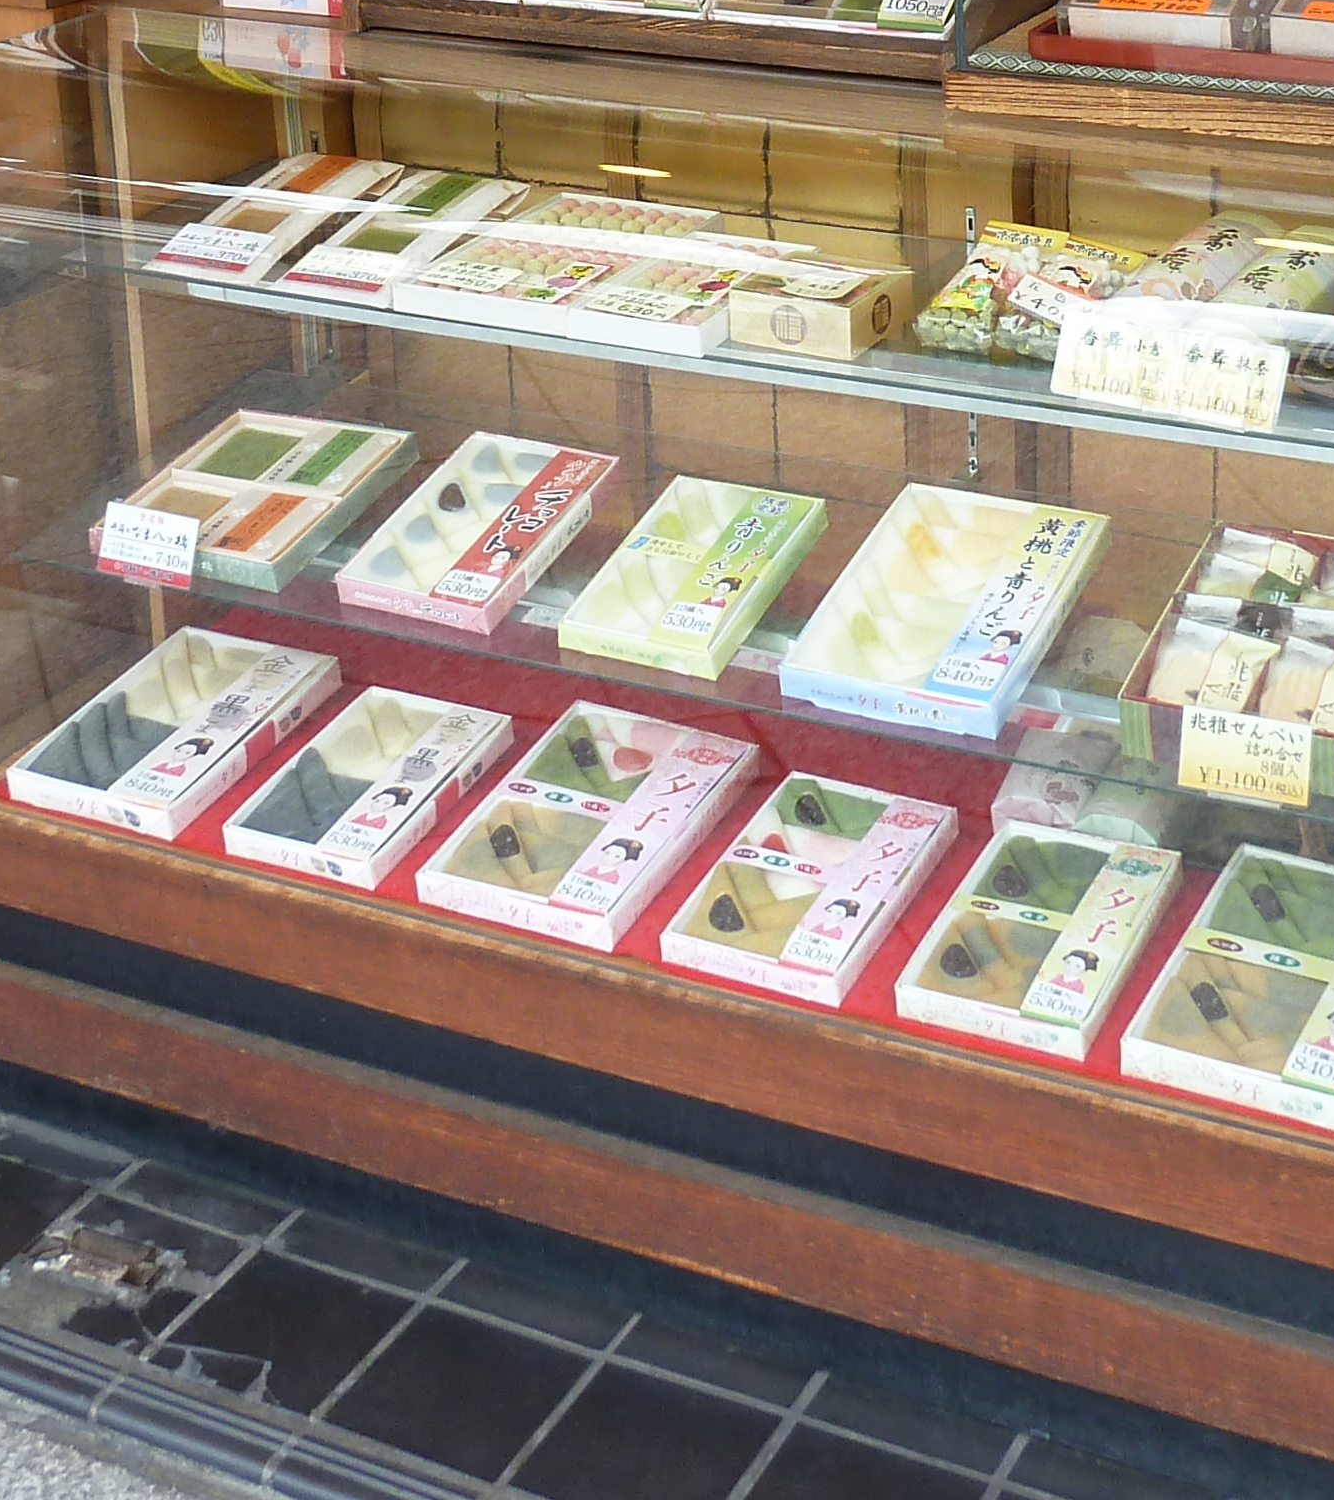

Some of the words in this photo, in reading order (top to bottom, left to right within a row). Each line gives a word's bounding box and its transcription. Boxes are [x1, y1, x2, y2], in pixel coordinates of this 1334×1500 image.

[1070, 372, 1131, 397] ¥1,100
[1174, 387, 1236, 415] ¥1,100
[483, 488, 574, 553] チョコレート
[155, 551, 190, 570] 740円
[697, 517, 766, 588] 青りんご
[438, 580, 481, 598] 530円
[978, 517, 1067, 638] 黄桃と青りんご
[662, 613, 706, 632] 530円
[935, 668, 989, 688] 840円
[1189, 712, 1305, 744] 兆雅せんべい
[1245, 741, 1304, 763] 詰め合せ
[1198, 766, 1267, 792] ¥1,100
[1269, 781, 1305, 798] (税込)
[1260, 760, 1300, 780] 8個入
[632, 773, 697, 832] 夕子
[848, 841, 903, 892] 夕子
[1081, 888, 1136, 943] 夕子
[787, 942, 832, 965] 530円
[1028, 993, 1078, 1017] 530円
